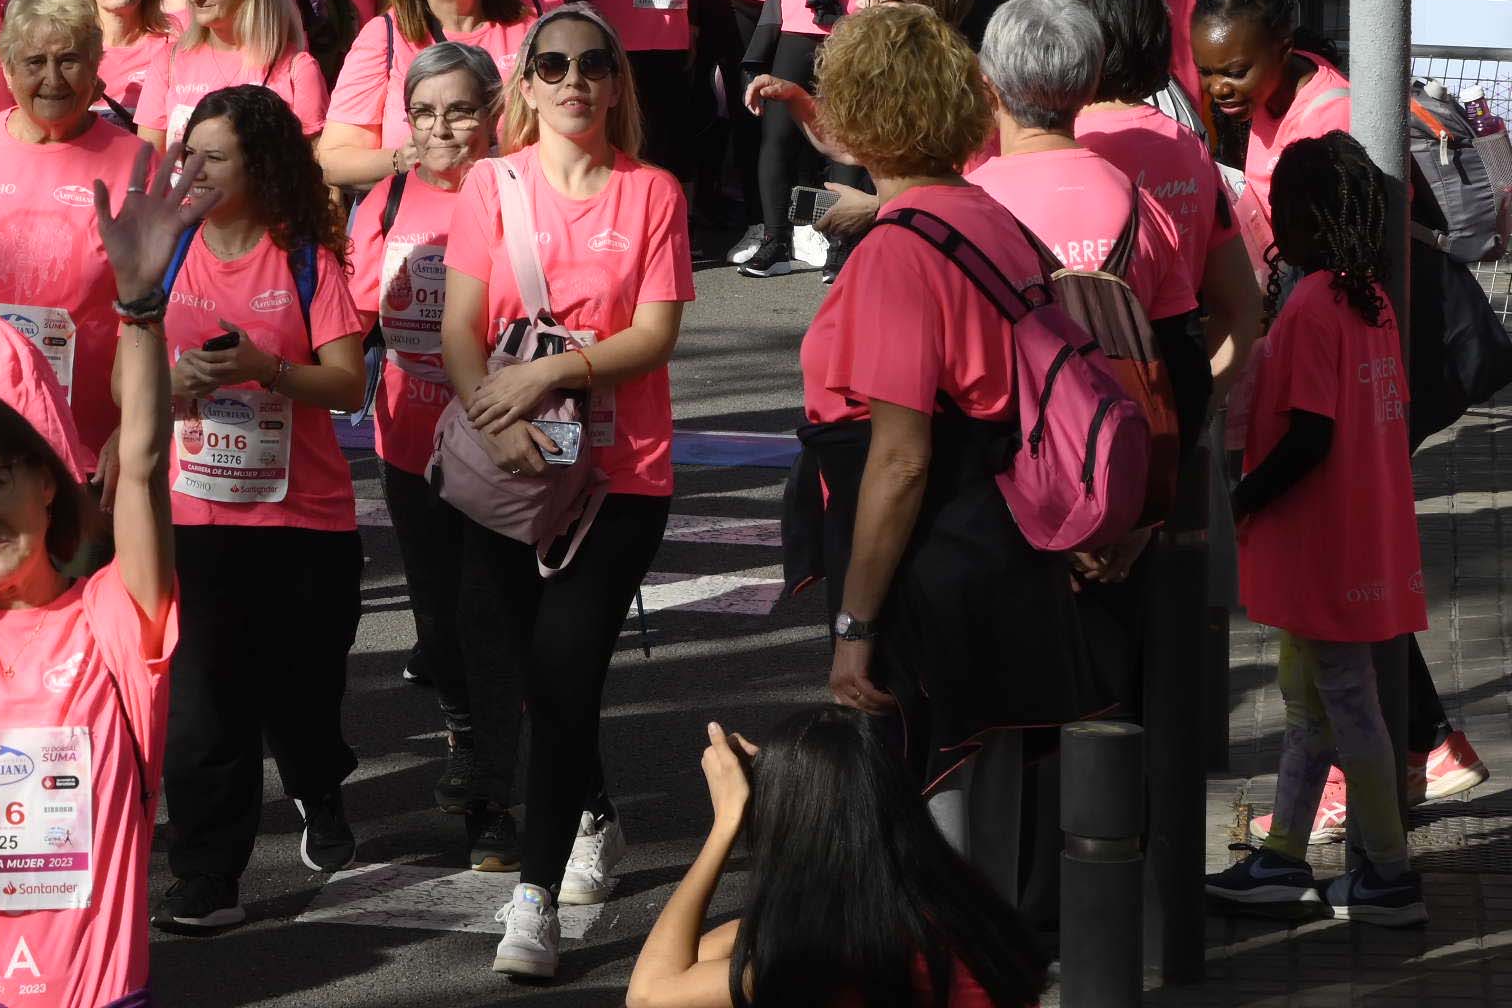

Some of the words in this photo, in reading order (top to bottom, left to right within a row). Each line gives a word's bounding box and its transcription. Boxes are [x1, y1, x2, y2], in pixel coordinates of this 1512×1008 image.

[415, 288, 445, 304] 01
[419, 308, 442, 320] 1237
[207, 432, 247, 450] 016
[211, 453, 242, 465] 12376
[187, 463, 211, 474] CARRERA
[42, 752, 77, 762] SUMA
[7, 858, 46, 869] MUJER
[48, 857, 74, 868] 2023
[19, 882, 79, 895] Santander
[18, 982, 47, 994] 2023
